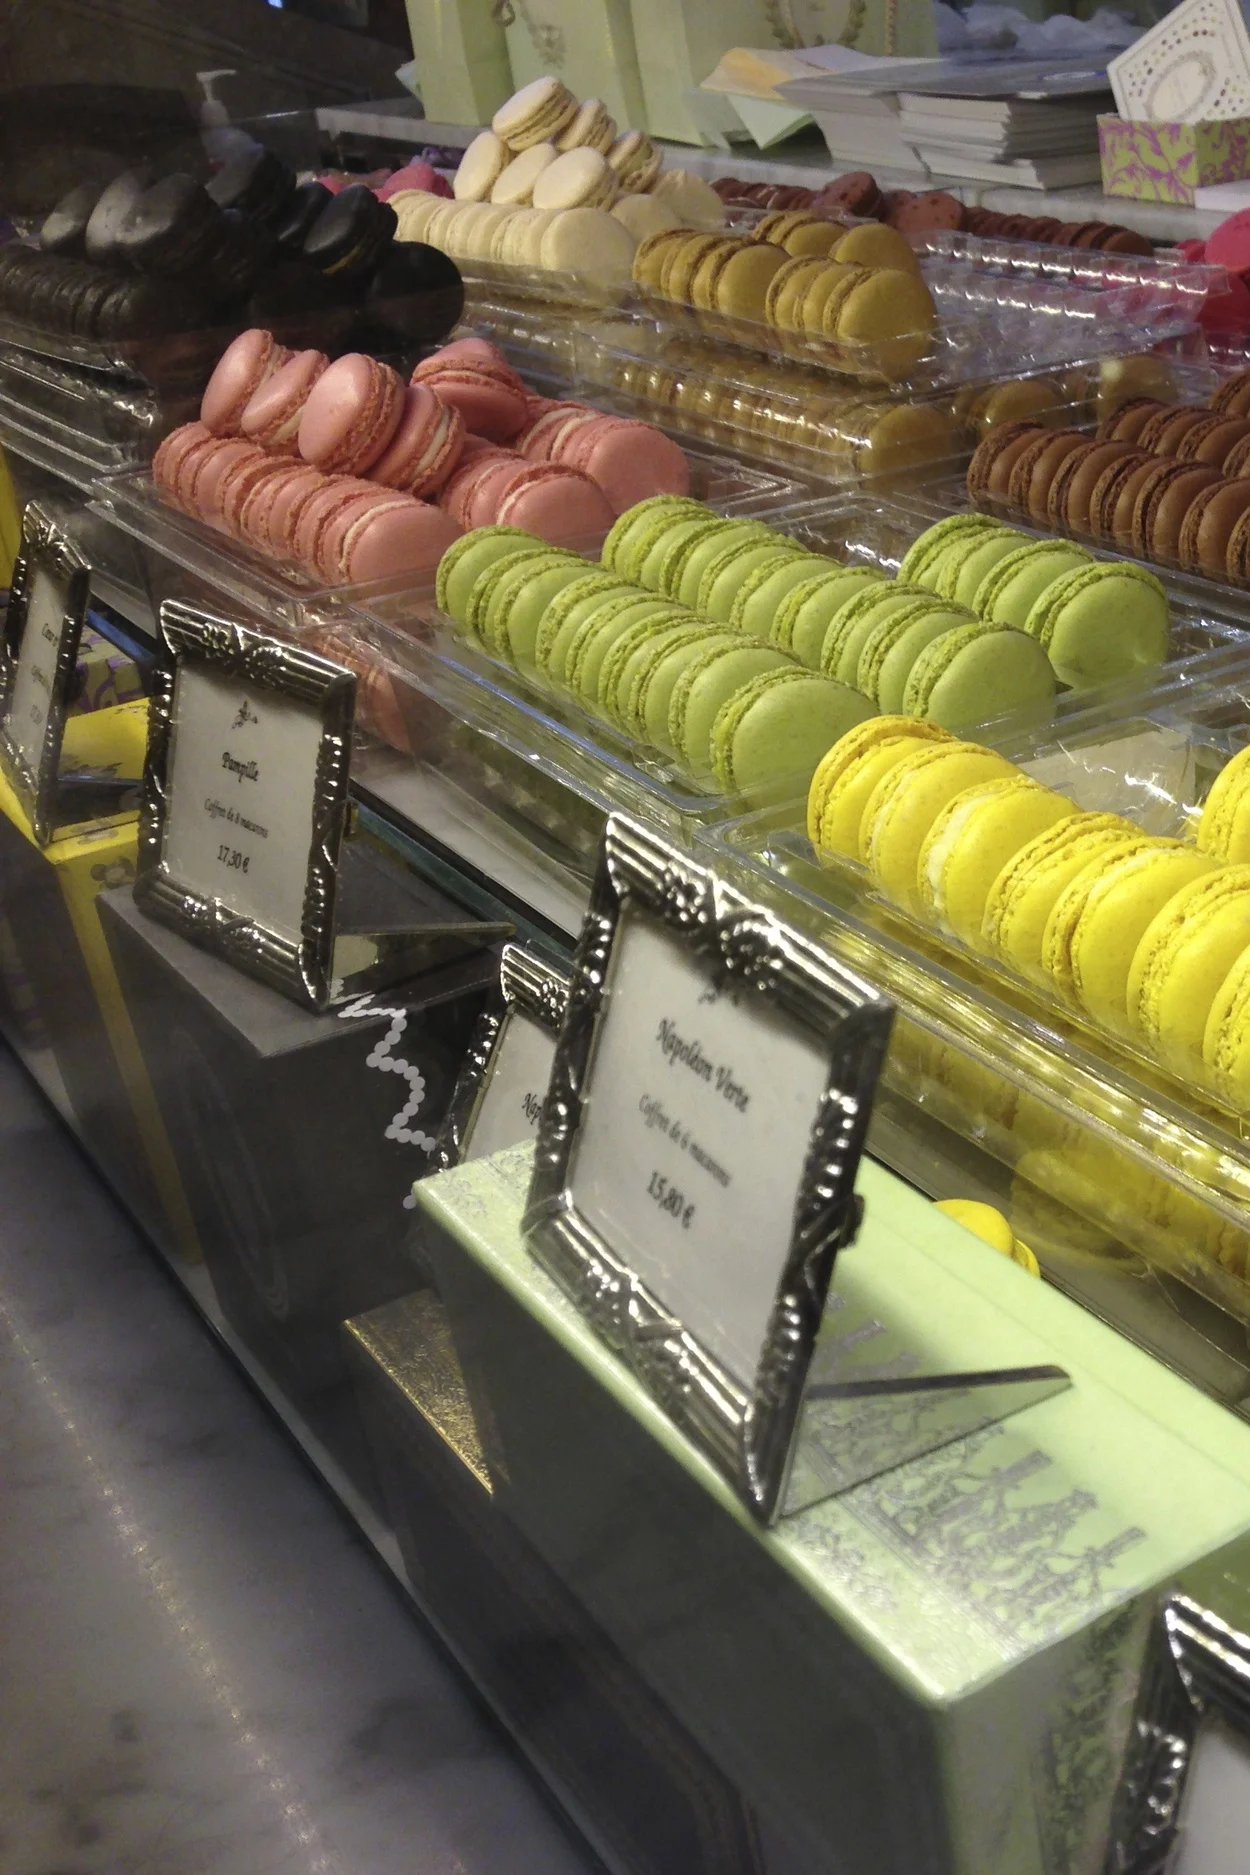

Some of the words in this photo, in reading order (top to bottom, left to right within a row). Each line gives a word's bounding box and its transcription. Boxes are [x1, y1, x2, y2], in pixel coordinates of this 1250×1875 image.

[221, 751, 259, 783] Pampille
[217, 844, 242, 869] 17,30
[242, 856, 251, 874] €
